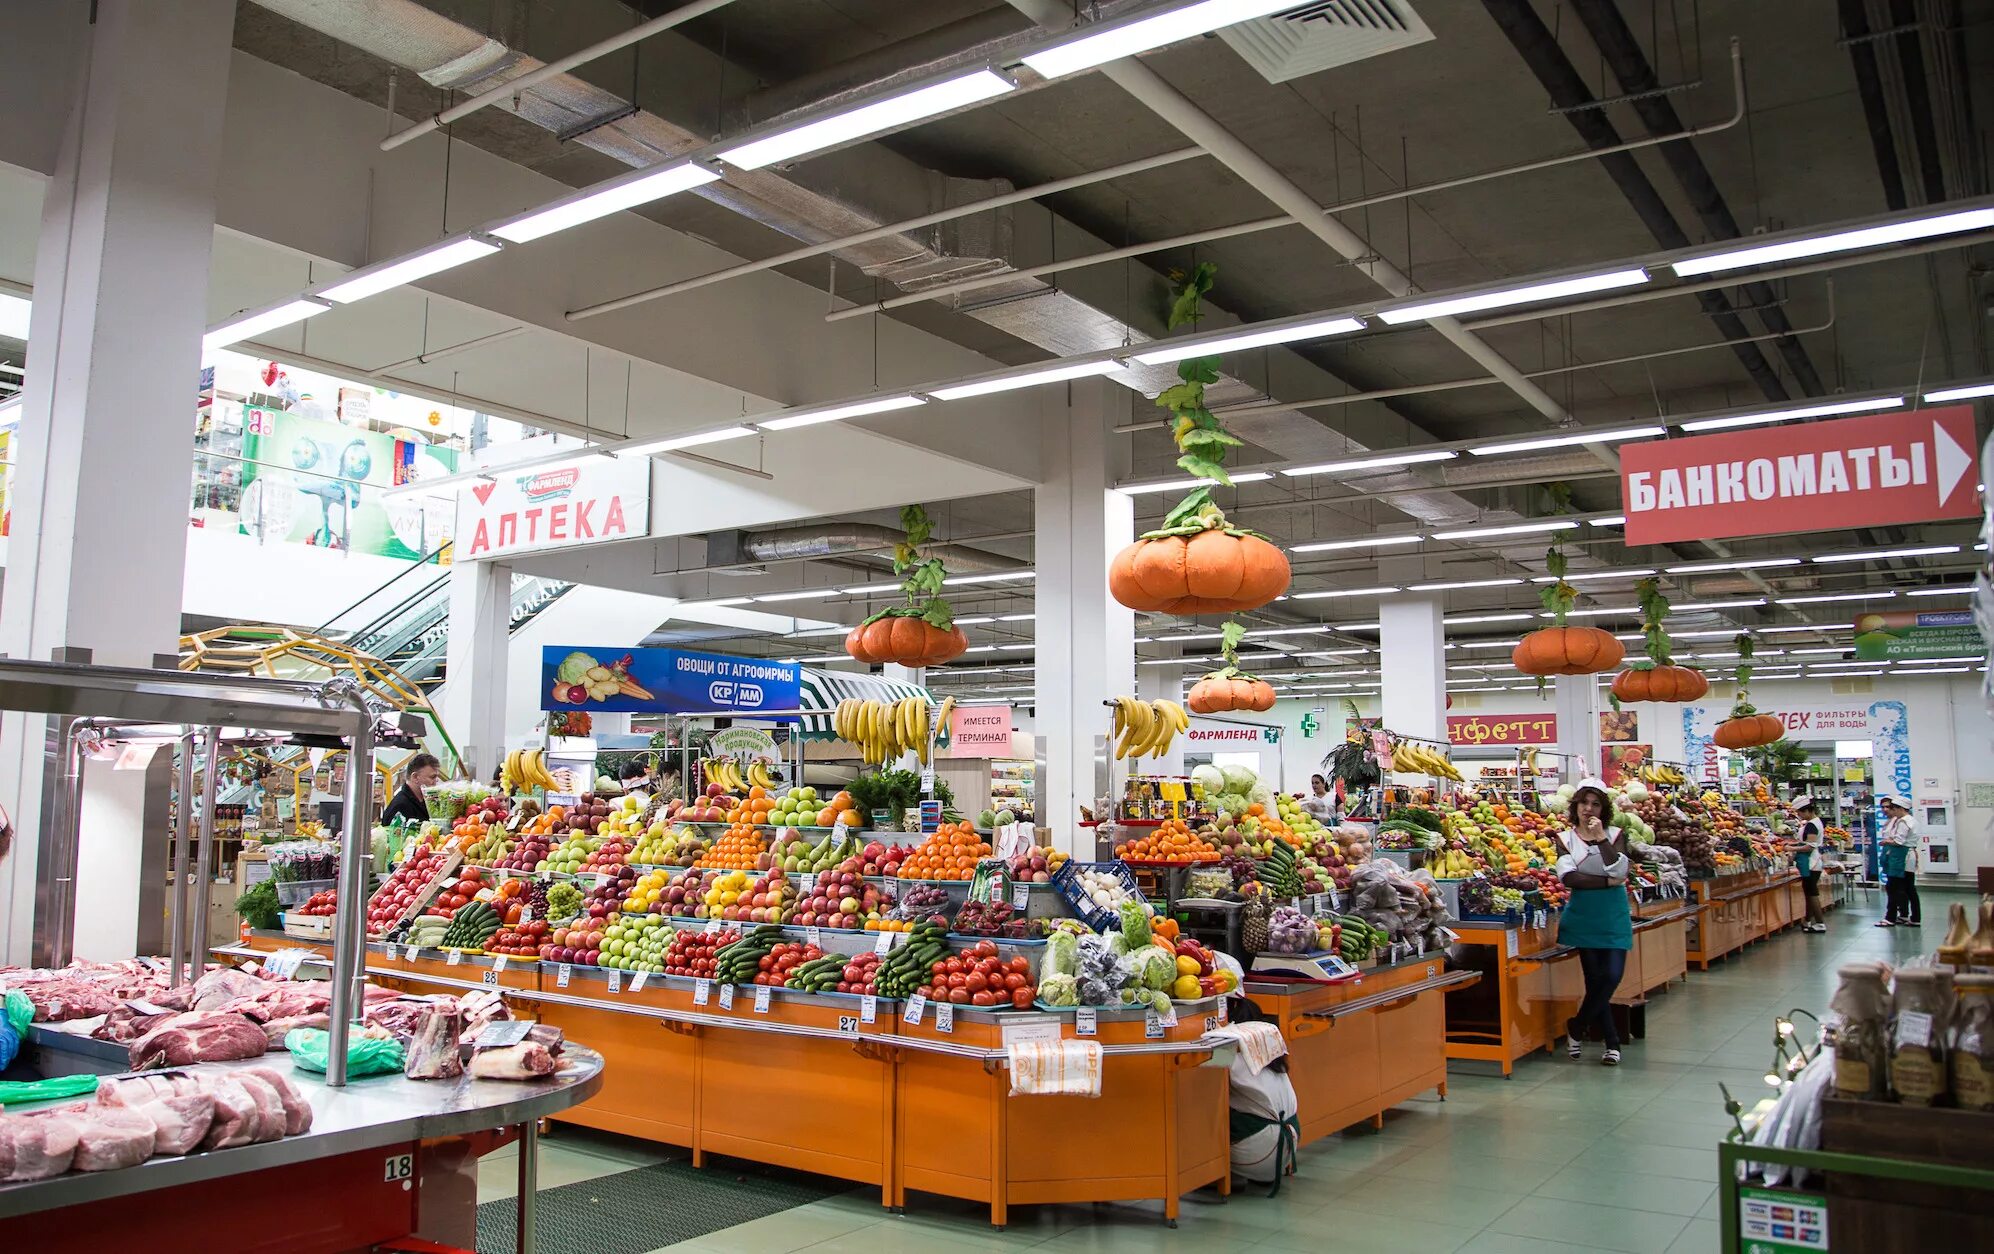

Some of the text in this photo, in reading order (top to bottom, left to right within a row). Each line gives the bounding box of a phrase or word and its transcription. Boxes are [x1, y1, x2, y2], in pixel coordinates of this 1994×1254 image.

[1629, 442, 1928, 512] БАНКОМАТЫ
[469, 495, 626, 555] АПТЕКА
[677, 657, 794, 683] ОВОЩИ ОТ АГРОФИРМЫ
[963, 716, 1001, 726] ИМЕЕТСЯ
[1815, 710, 1866, 719] ФИЛЬТРЫ
[1816, 720, 1866, 729] ДЛЯ ВОДЫ
[958, 732, 1007, 743] ТЕРМИНАЛ
[1188, 728, 1257, 741] ФАРМЛЕНД
[484, 971, 497, 984] 28
[841, 1017, 857, 1031] 27
[1206, 1017, 1217, 1031] 26
[385, 1155, 412, 1181] 18
